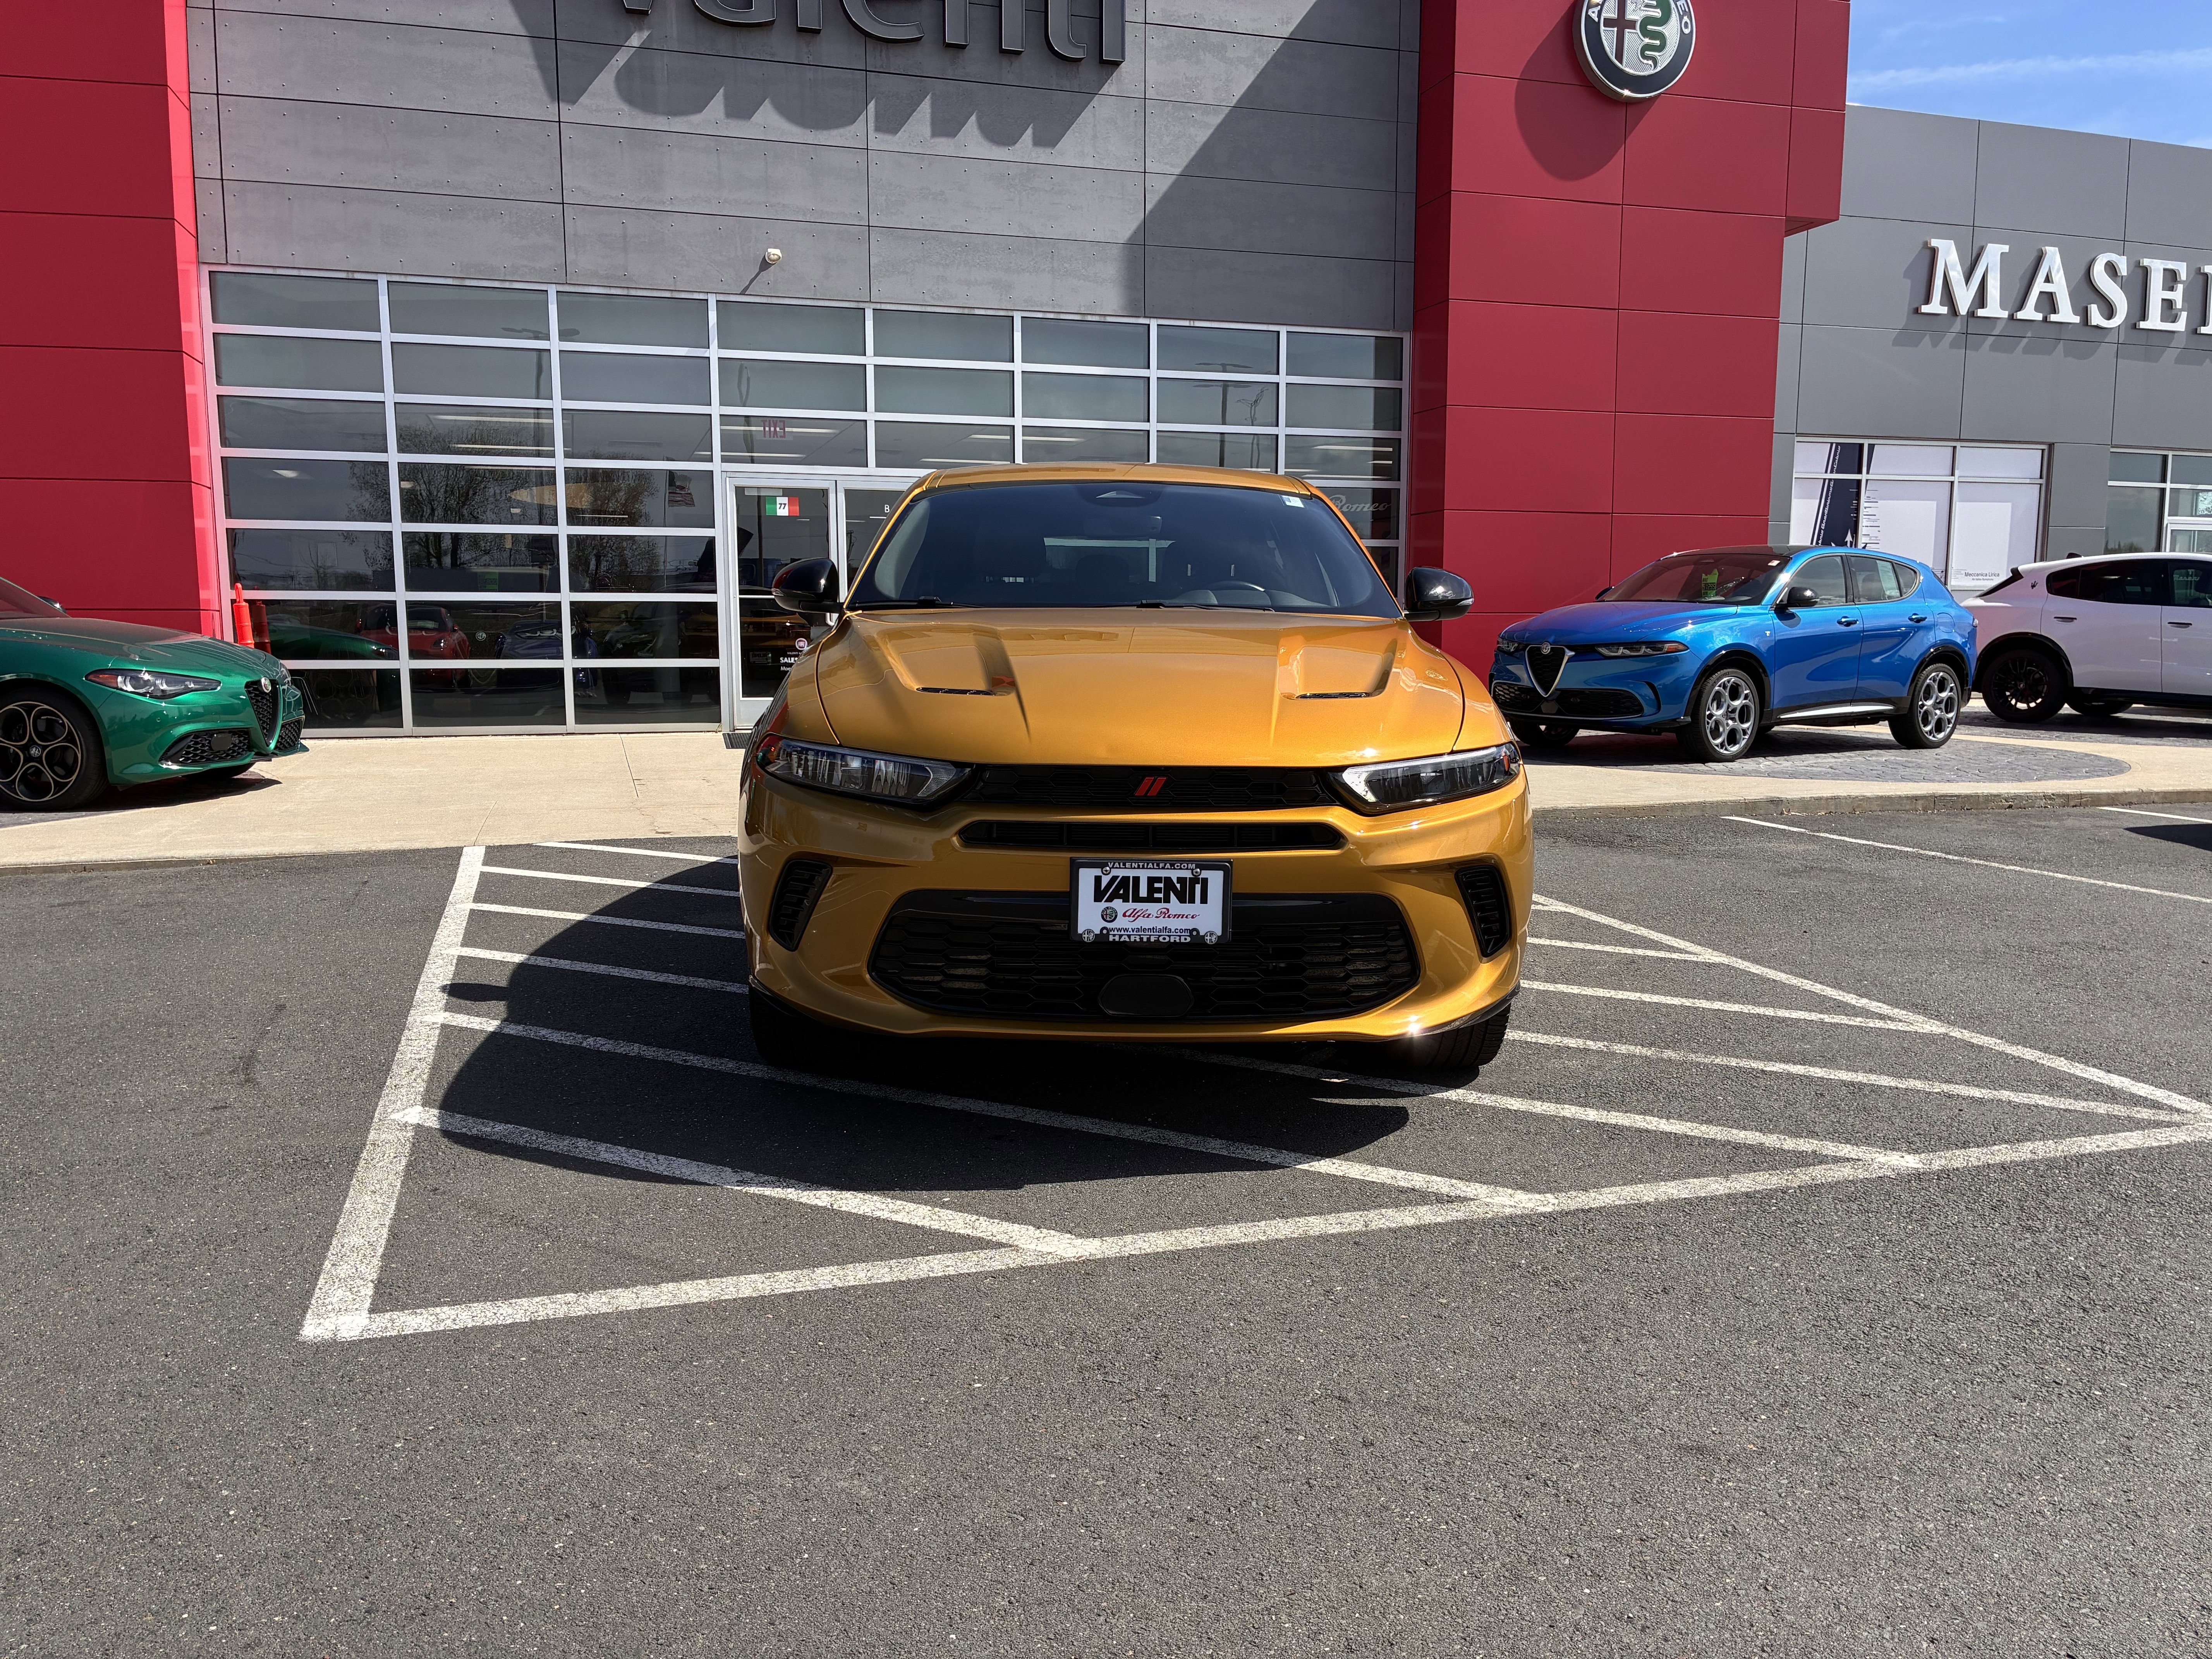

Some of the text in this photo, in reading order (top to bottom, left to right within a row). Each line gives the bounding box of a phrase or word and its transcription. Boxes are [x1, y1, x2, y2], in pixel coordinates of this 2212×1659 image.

[1329, 495, 1391, 512] Romeo
[1094, 875, 1209, 905] VALENTI
[1122, 908, 1154, 922] Alfa
[1154, 907, 1200, 919] Romeo
[1109, 926, 1191, 934] www.valentialfa.com
[1109, 934, 1191, 943] HARTFORD
